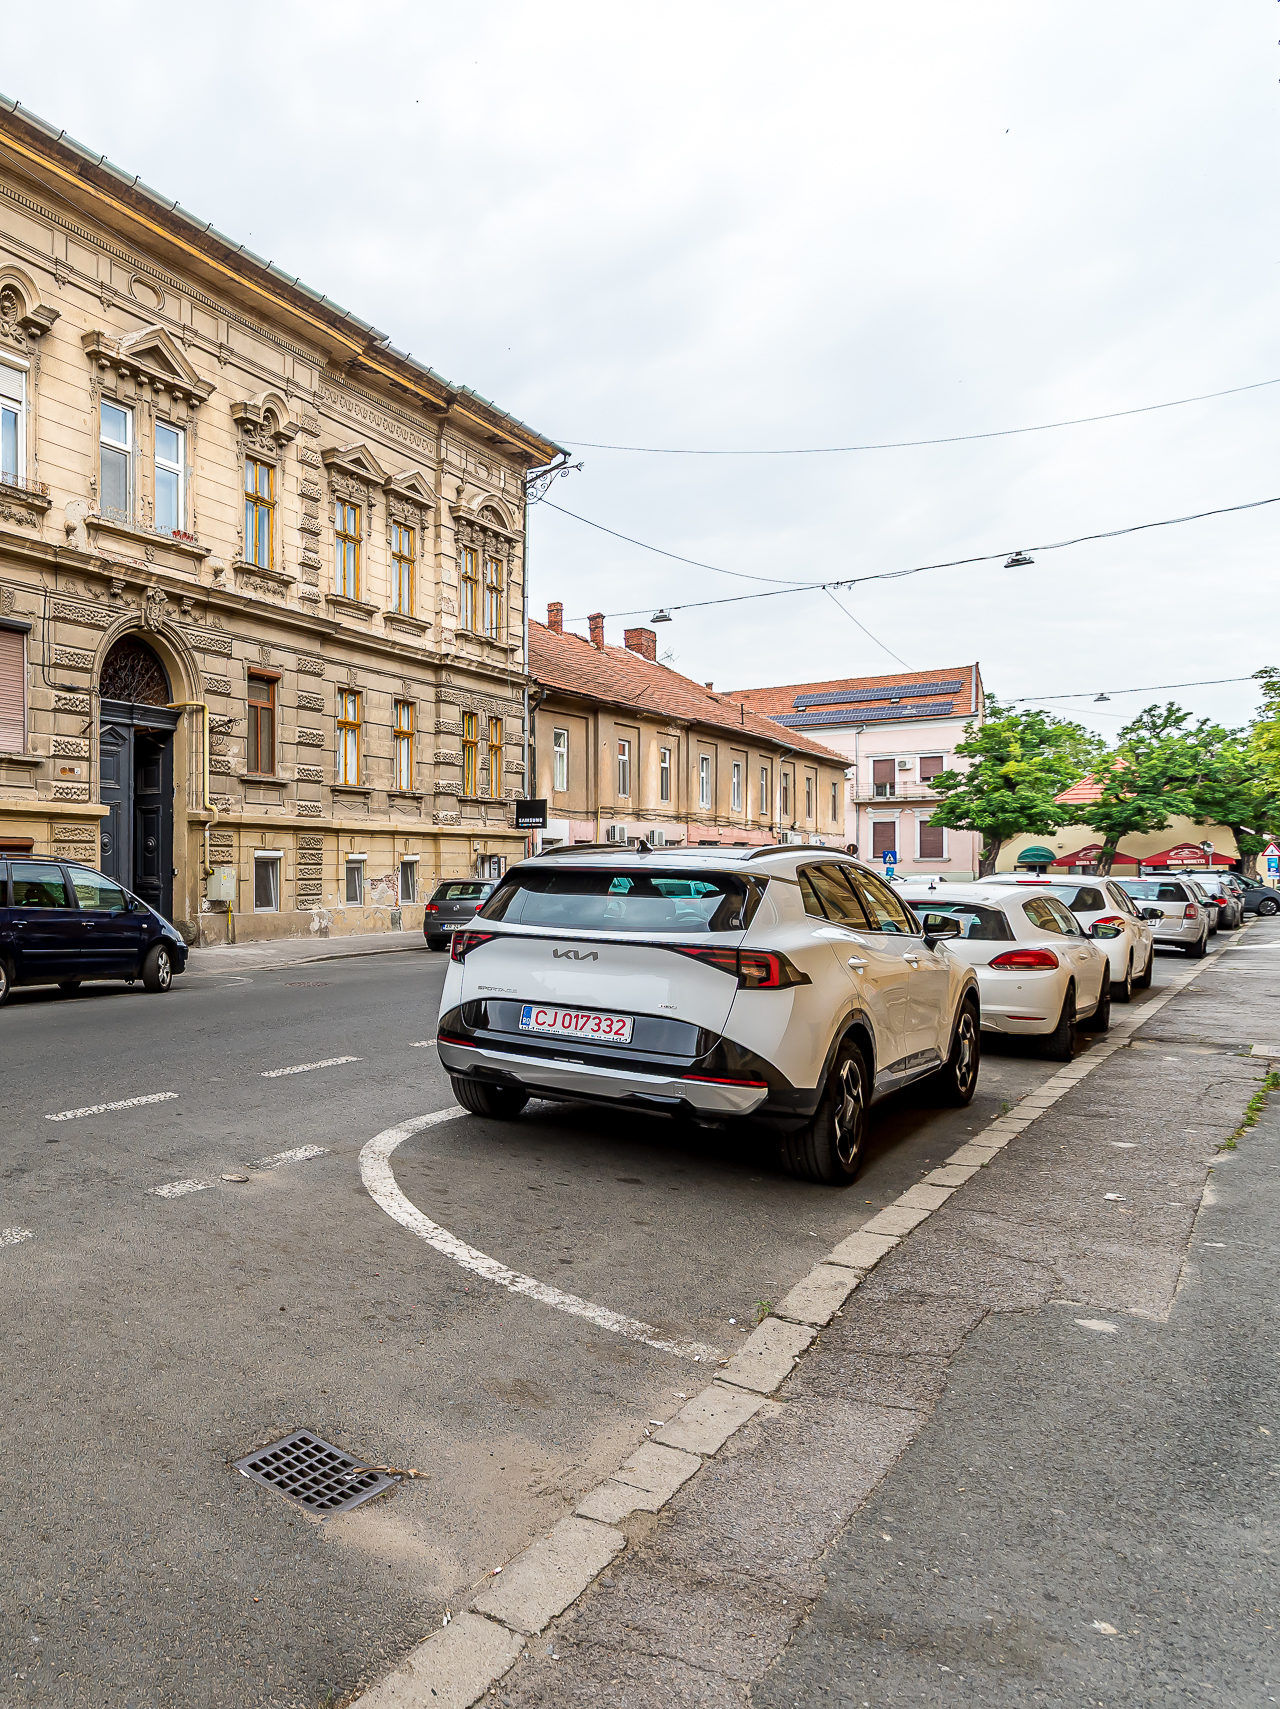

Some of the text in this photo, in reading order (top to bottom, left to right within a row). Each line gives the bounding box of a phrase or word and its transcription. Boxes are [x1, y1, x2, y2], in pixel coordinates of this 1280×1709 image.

[553, 948, 599, 961] KIA
[535, 1010, 558, 1027] CJ
[561, 1013, 626, 1037] 017332
